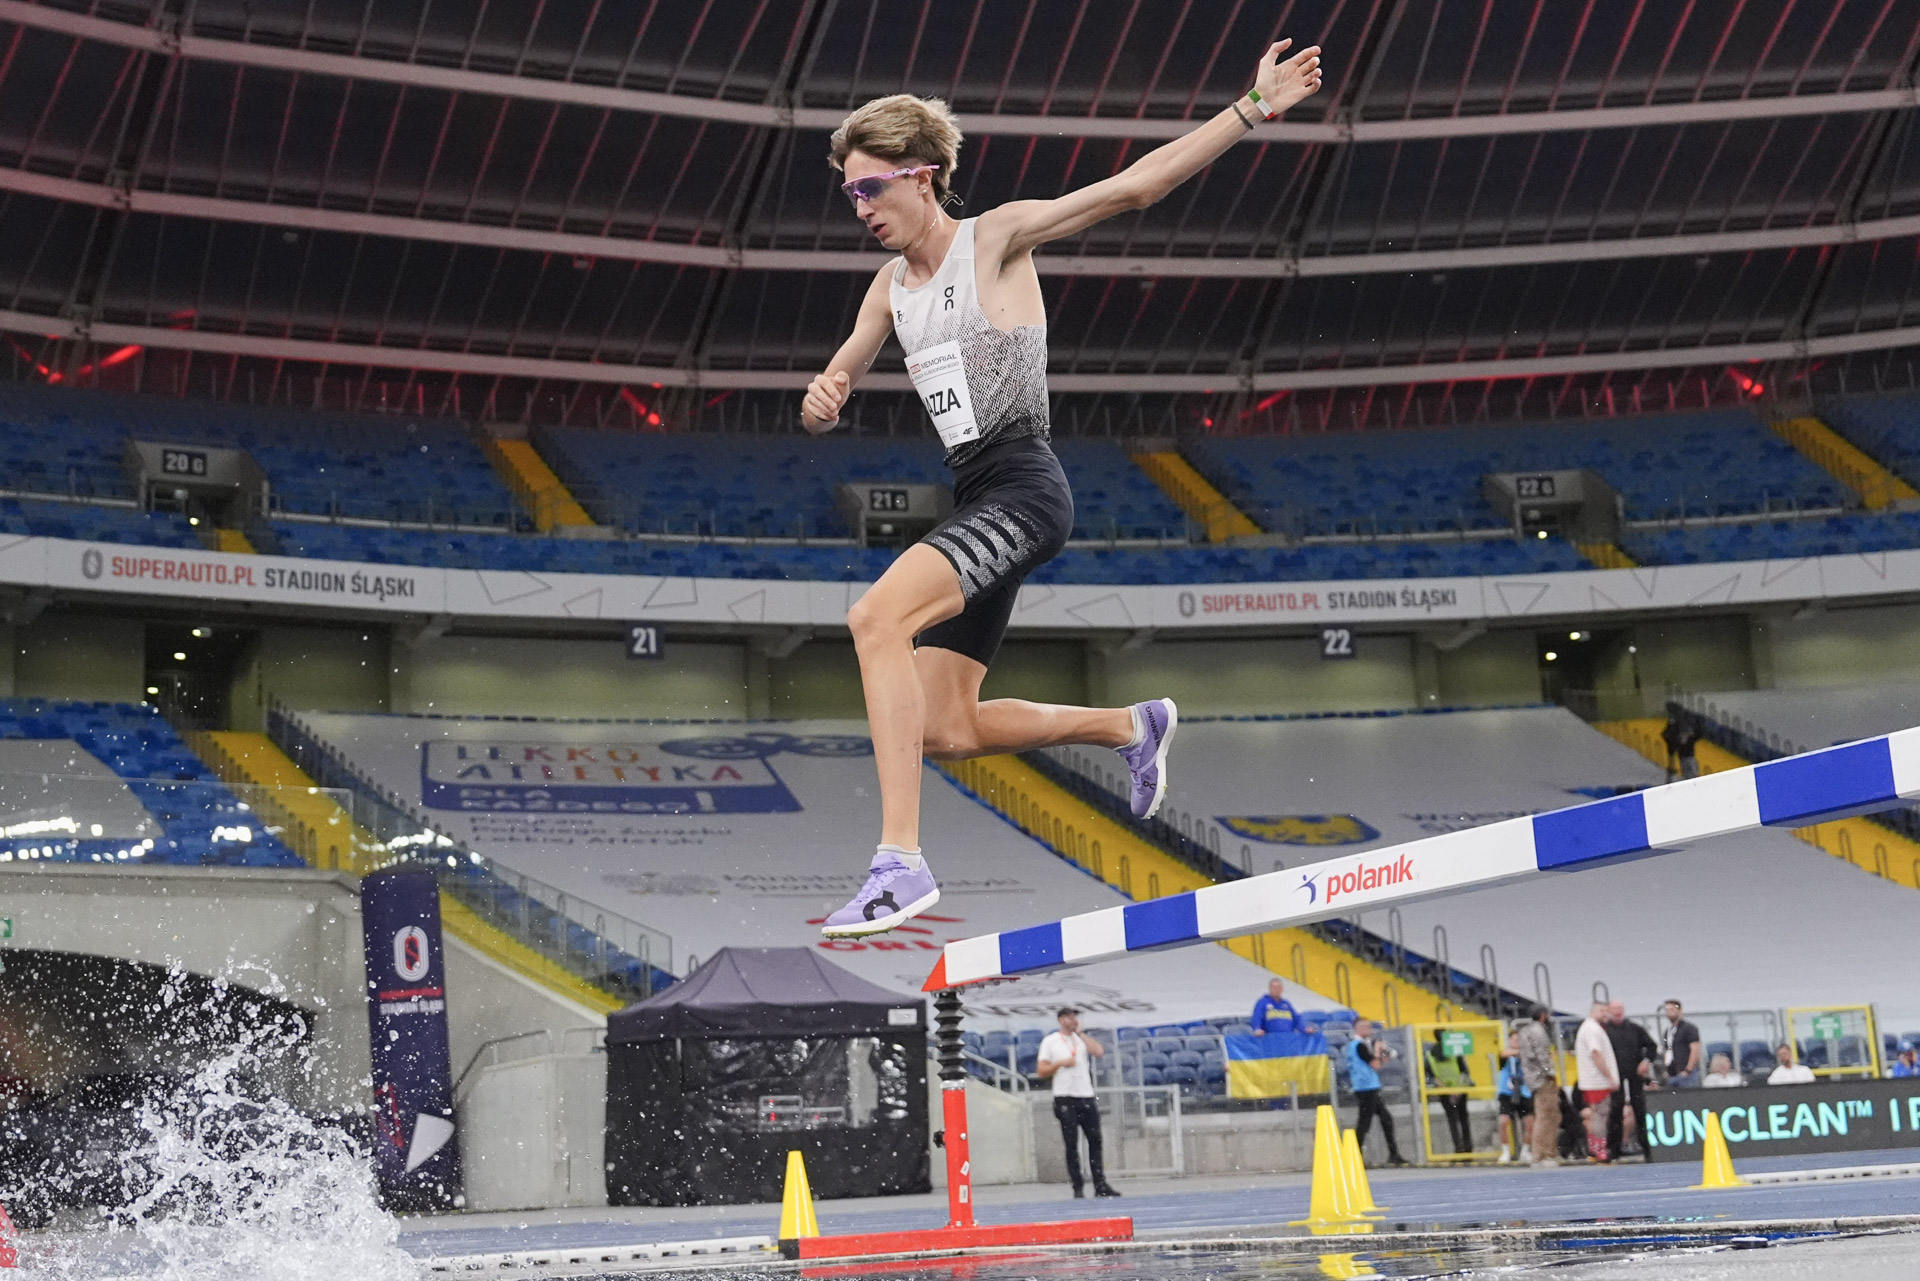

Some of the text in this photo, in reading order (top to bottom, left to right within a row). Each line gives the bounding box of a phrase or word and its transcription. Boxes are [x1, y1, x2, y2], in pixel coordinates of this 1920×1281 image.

[923, 388, 961, 417] AZZA
[166, 452, 188, 471] 20
[873, 491, 891, 508] 21
[112, 556, 415, 602] SUPERAUTO.PL STADION ŚLĄSKI
[1202, 586, 1457, 614] SUPERAUTO.PL STADION ŚLĄSKI
[632, 627, 657, 654] 21
[1323, 629, 1352, 655] 22
[1326, 853, 1414, 904] polanik
[1646, 1108, 1710, 1147] RUN
